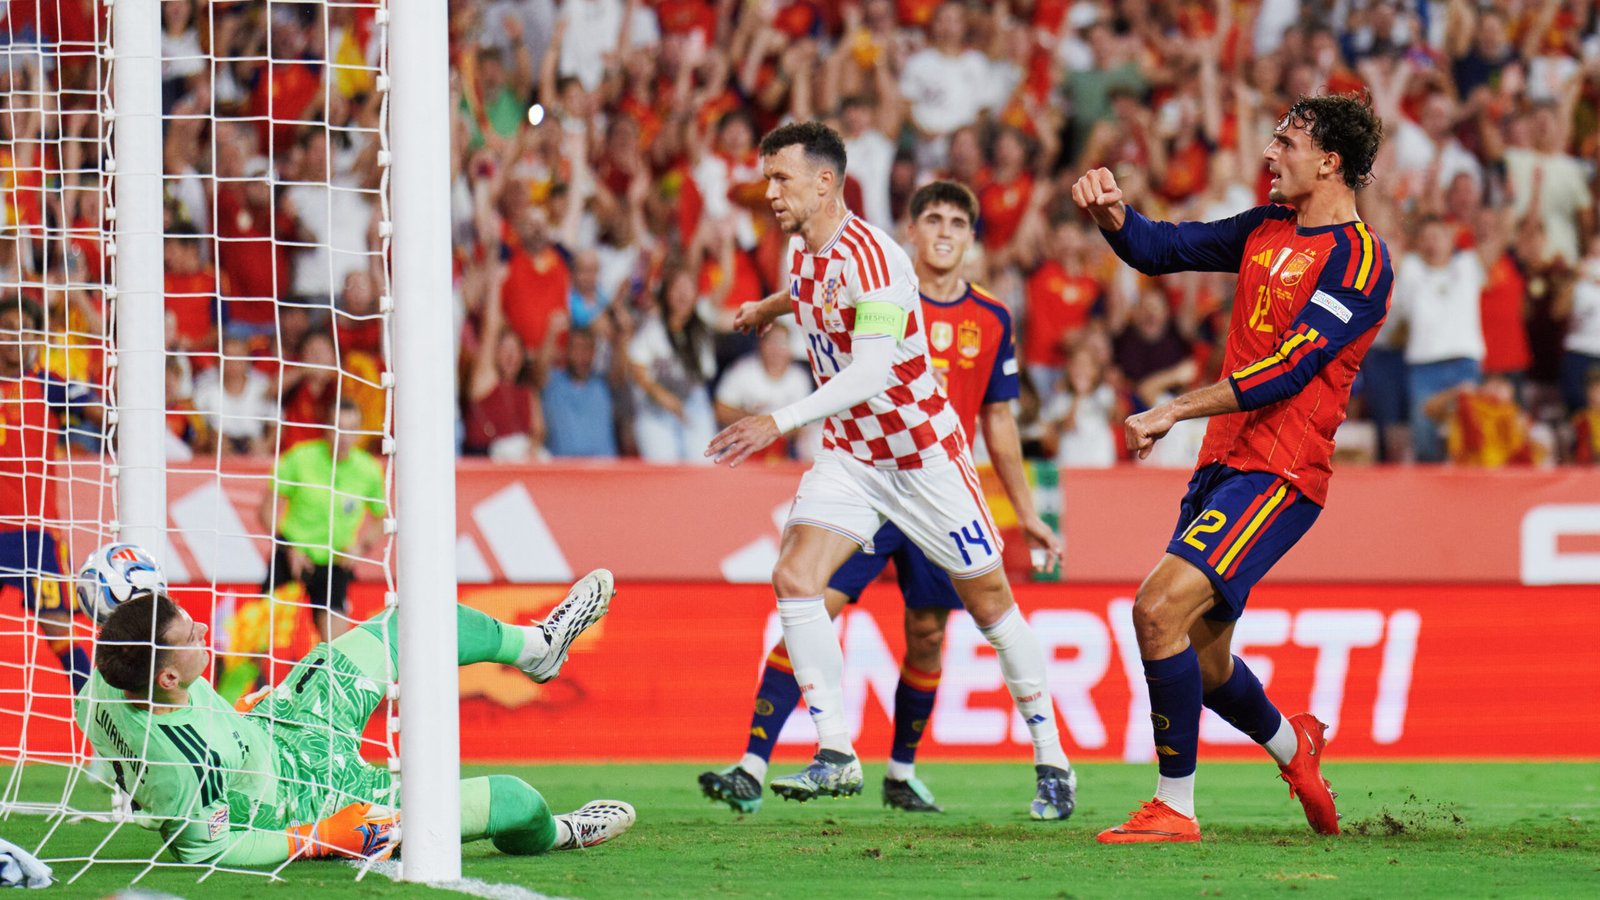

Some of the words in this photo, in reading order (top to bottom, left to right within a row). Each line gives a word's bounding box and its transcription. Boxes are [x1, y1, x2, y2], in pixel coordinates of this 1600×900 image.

[864, 313, 896, 323] RESPECT
[1249, 285, 1273, 333] 12
[808, 333, 840, 373] 14
[949, 519, 992, 566] 14
